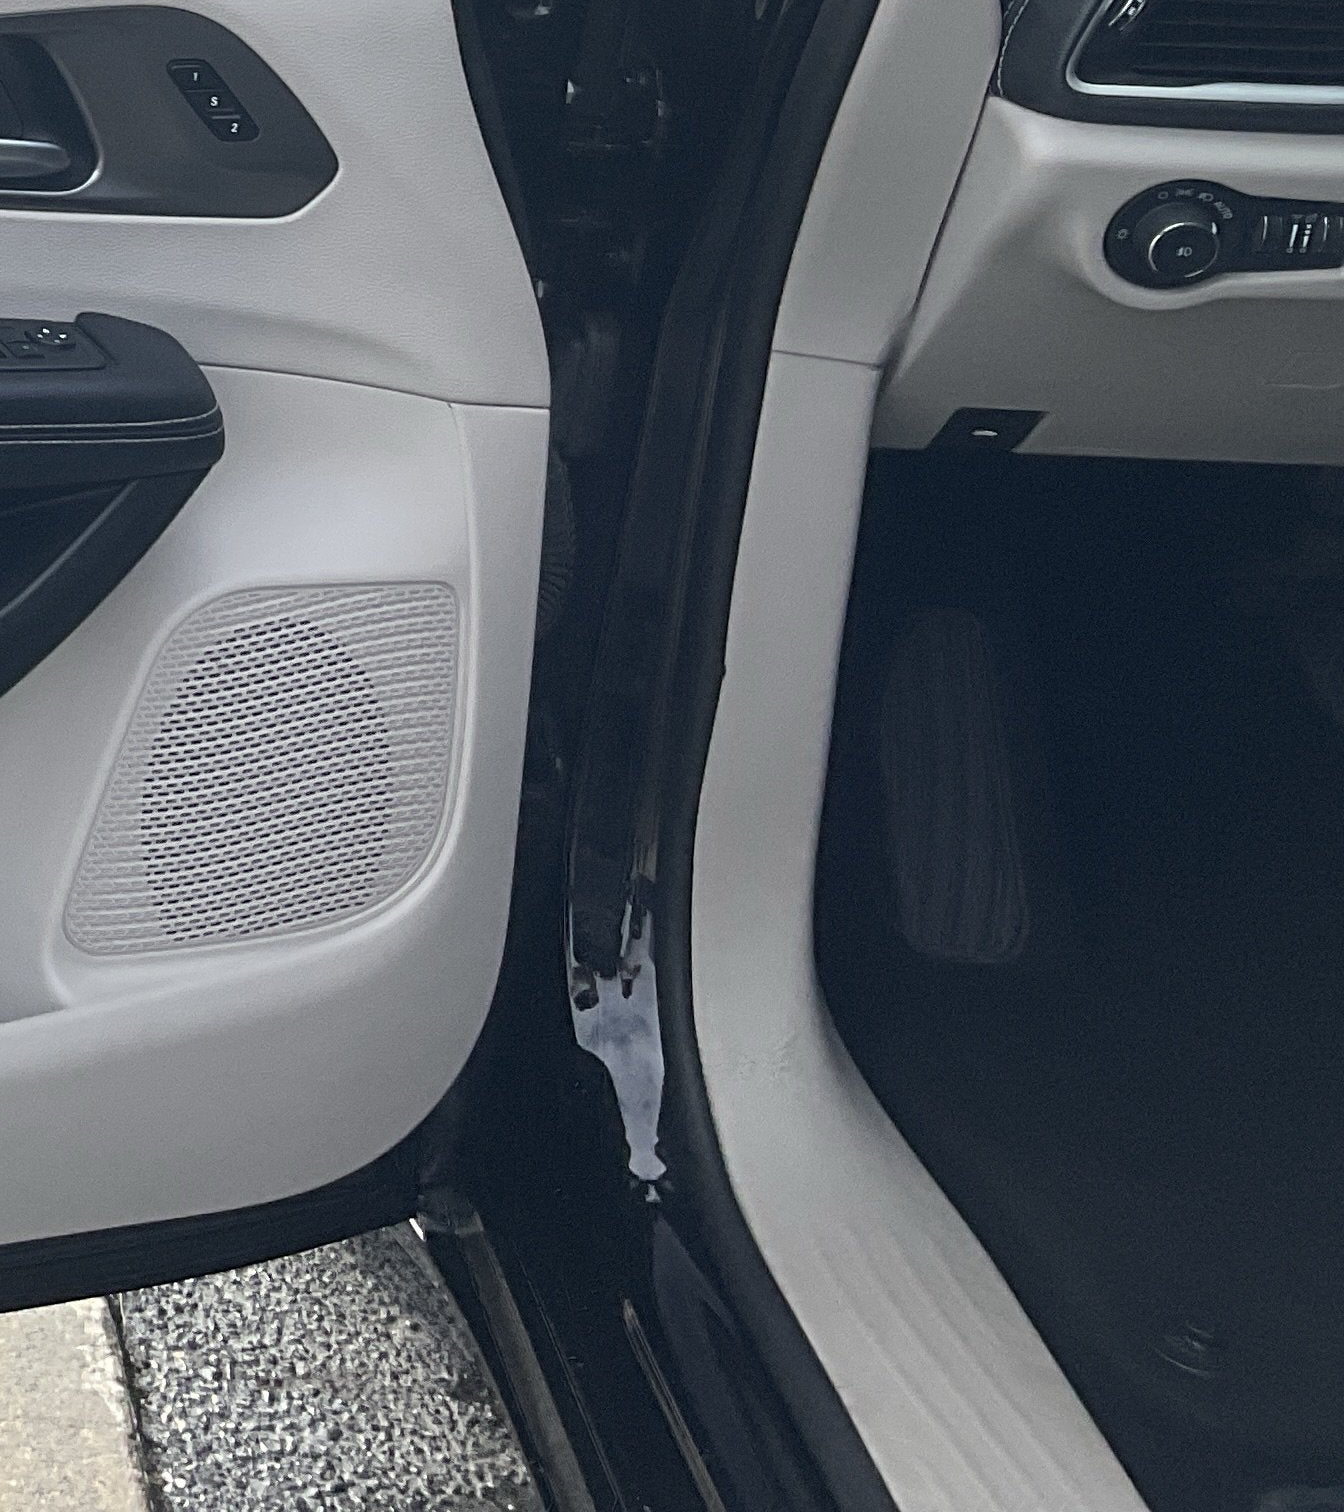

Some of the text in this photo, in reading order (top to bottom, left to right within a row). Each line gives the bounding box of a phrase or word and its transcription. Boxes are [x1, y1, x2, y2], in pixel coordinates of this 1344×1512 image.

[193, 72, 198, 82] 1
[210, 96, 219, 107] S
[230, 122, 239, 133] 2
